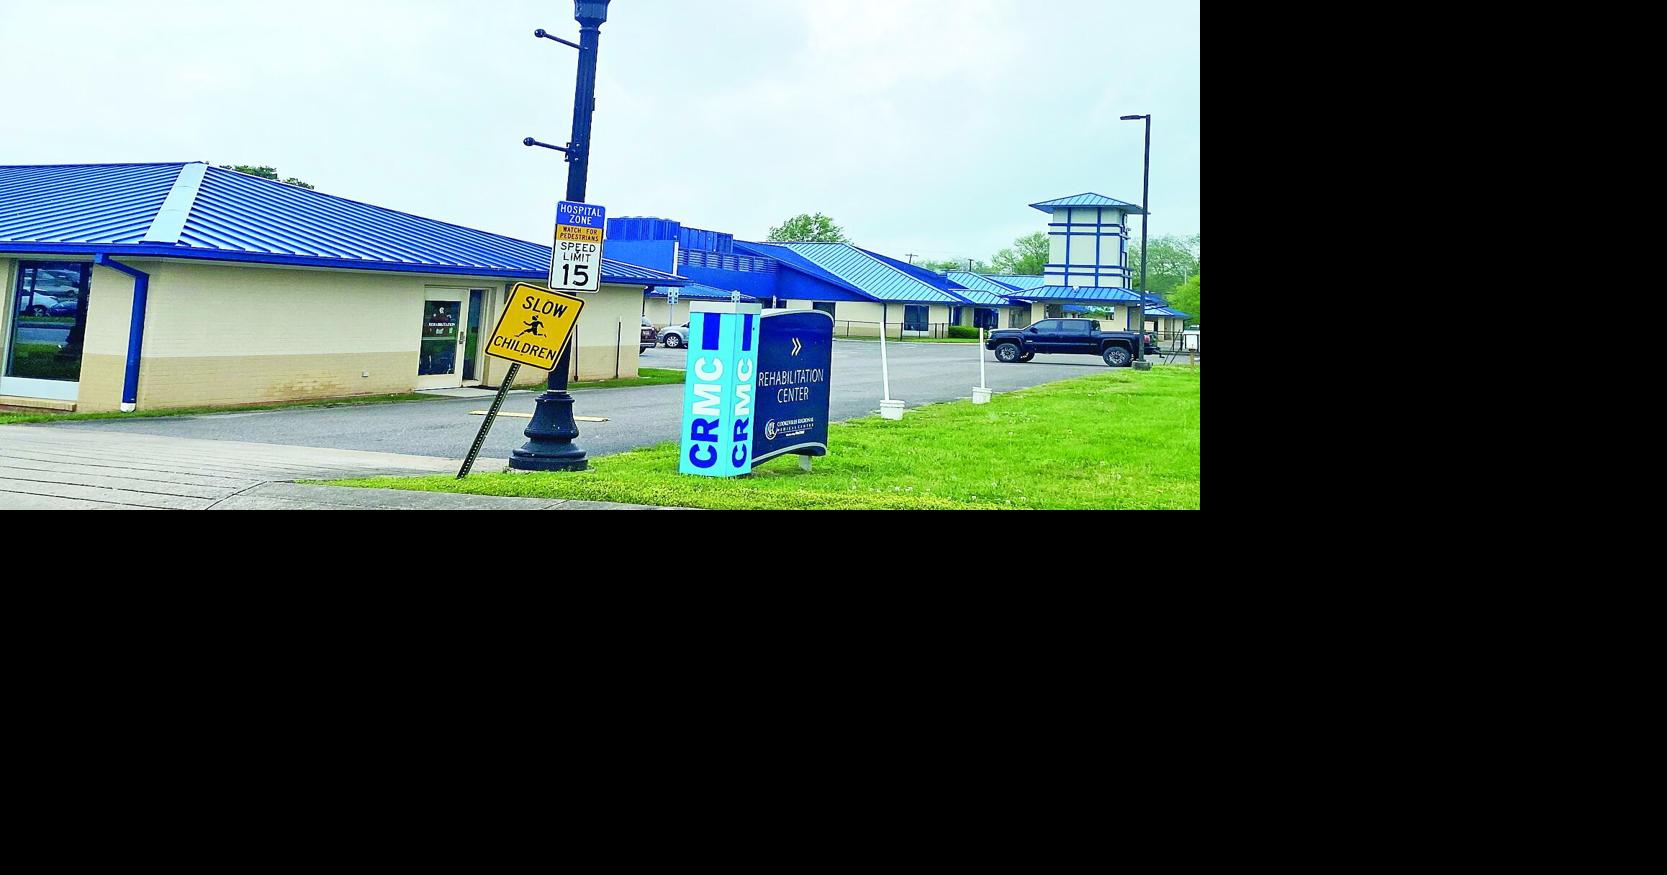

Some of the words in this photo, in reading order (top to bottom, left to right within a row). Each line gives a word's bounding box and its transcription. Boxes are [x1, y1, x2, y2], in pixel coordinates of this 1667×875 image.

[560, 204, 601, 217] HOSPITAL
[569, 214, 592, 225] ZONE
[560, 232, 599, 242] PEDESTRIANS
[562, 226, 582, 234] WATCH
[560, 242, 596, 253] SPEED
[563, 252, 591, 263] LIMIT
[562, 263, 589, 287] 15
[522, 295, 568, 318] SLOW
[493, 335, 557, 361] CHILDREN
[758, 368, 824, 387] REHABILITATION
[777, 386, 809, 403] CENTER
[689, 357, 724, 469] CRMC
[732, 357, 753, 468] CRMC
